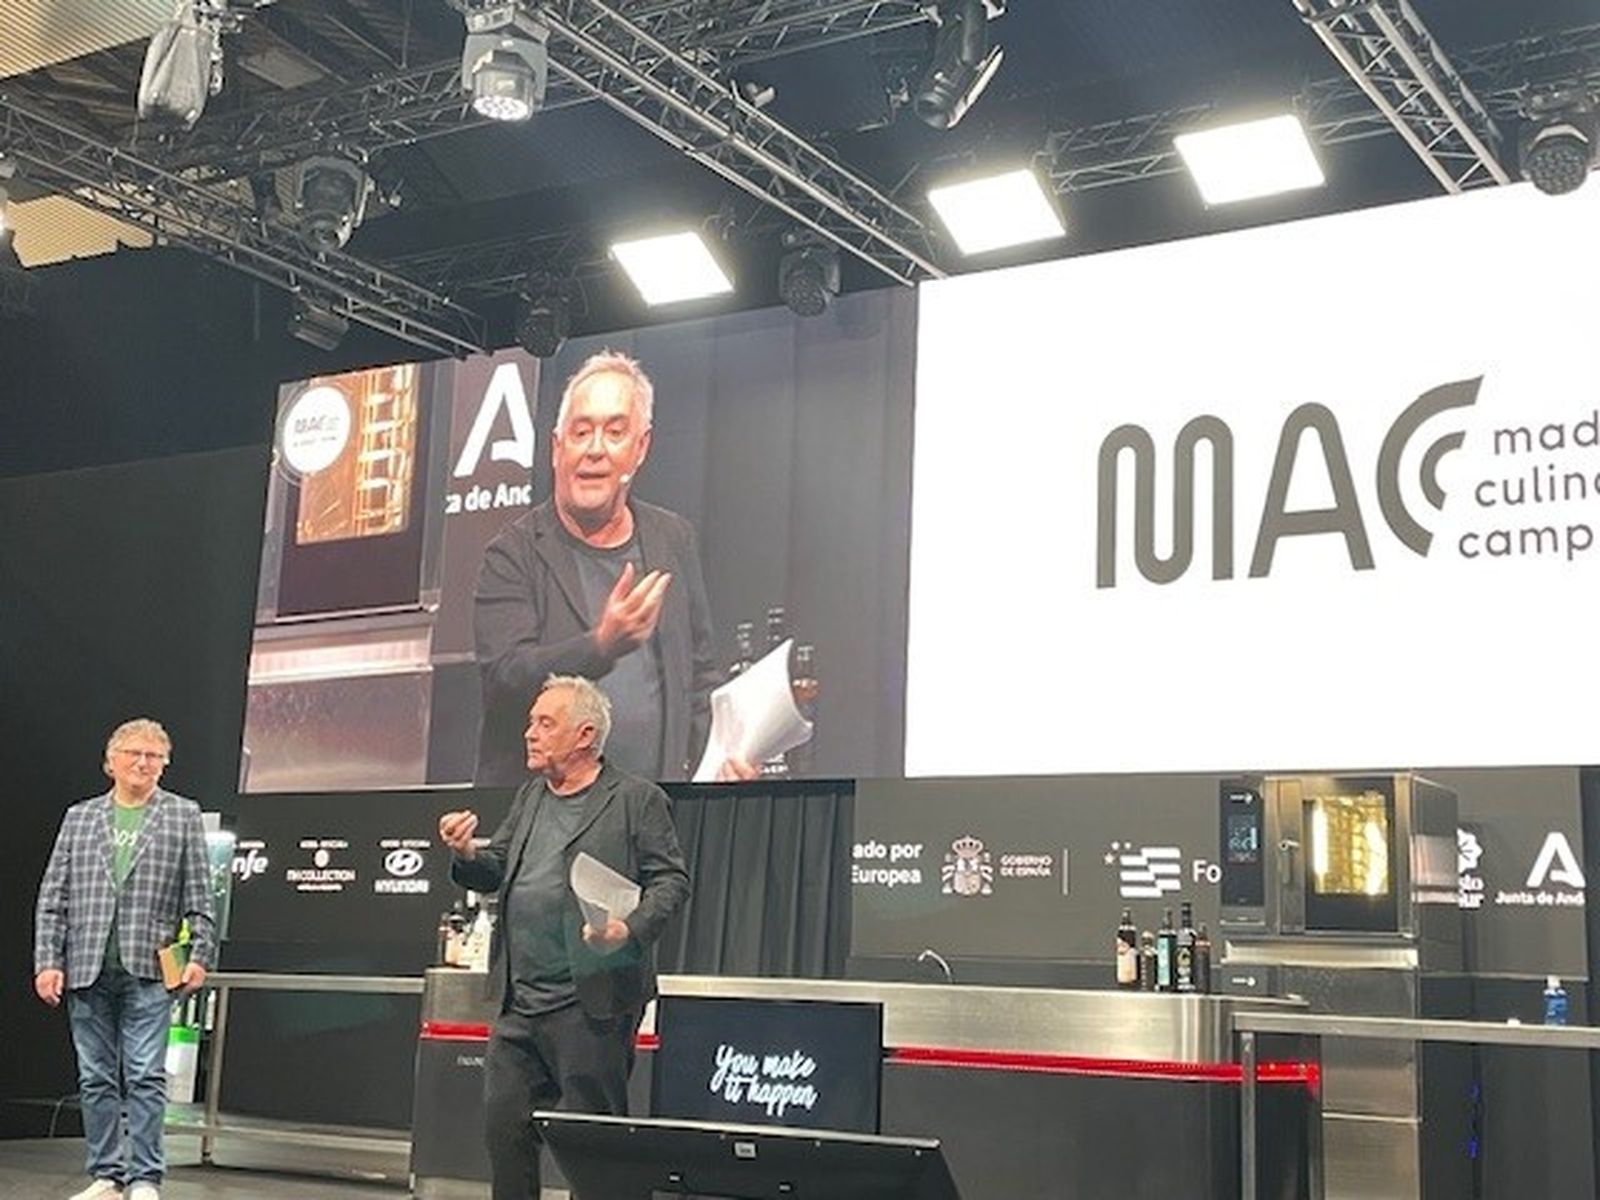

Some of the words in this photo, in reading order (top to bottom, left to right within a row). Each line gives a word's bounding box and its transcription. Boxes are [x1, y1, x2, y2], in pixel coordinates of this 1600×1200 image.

[1494, 410, 1599, 455] mad
[465, 485, 492, 511] de
[1459, 524, 1593, 561] camp
[890, 843, 922, 863] por
[852, 864, 922, 888] Europea
[1193, 860, 1221, 883] Fo
[1495, 890, 1534, 905] Junta
[1536, 891, 1553, 905] de
[709, 1044, 760, 1093] You
[761, 1049, 817, 1080] make
[747, 1073, 819, 1117] happen
